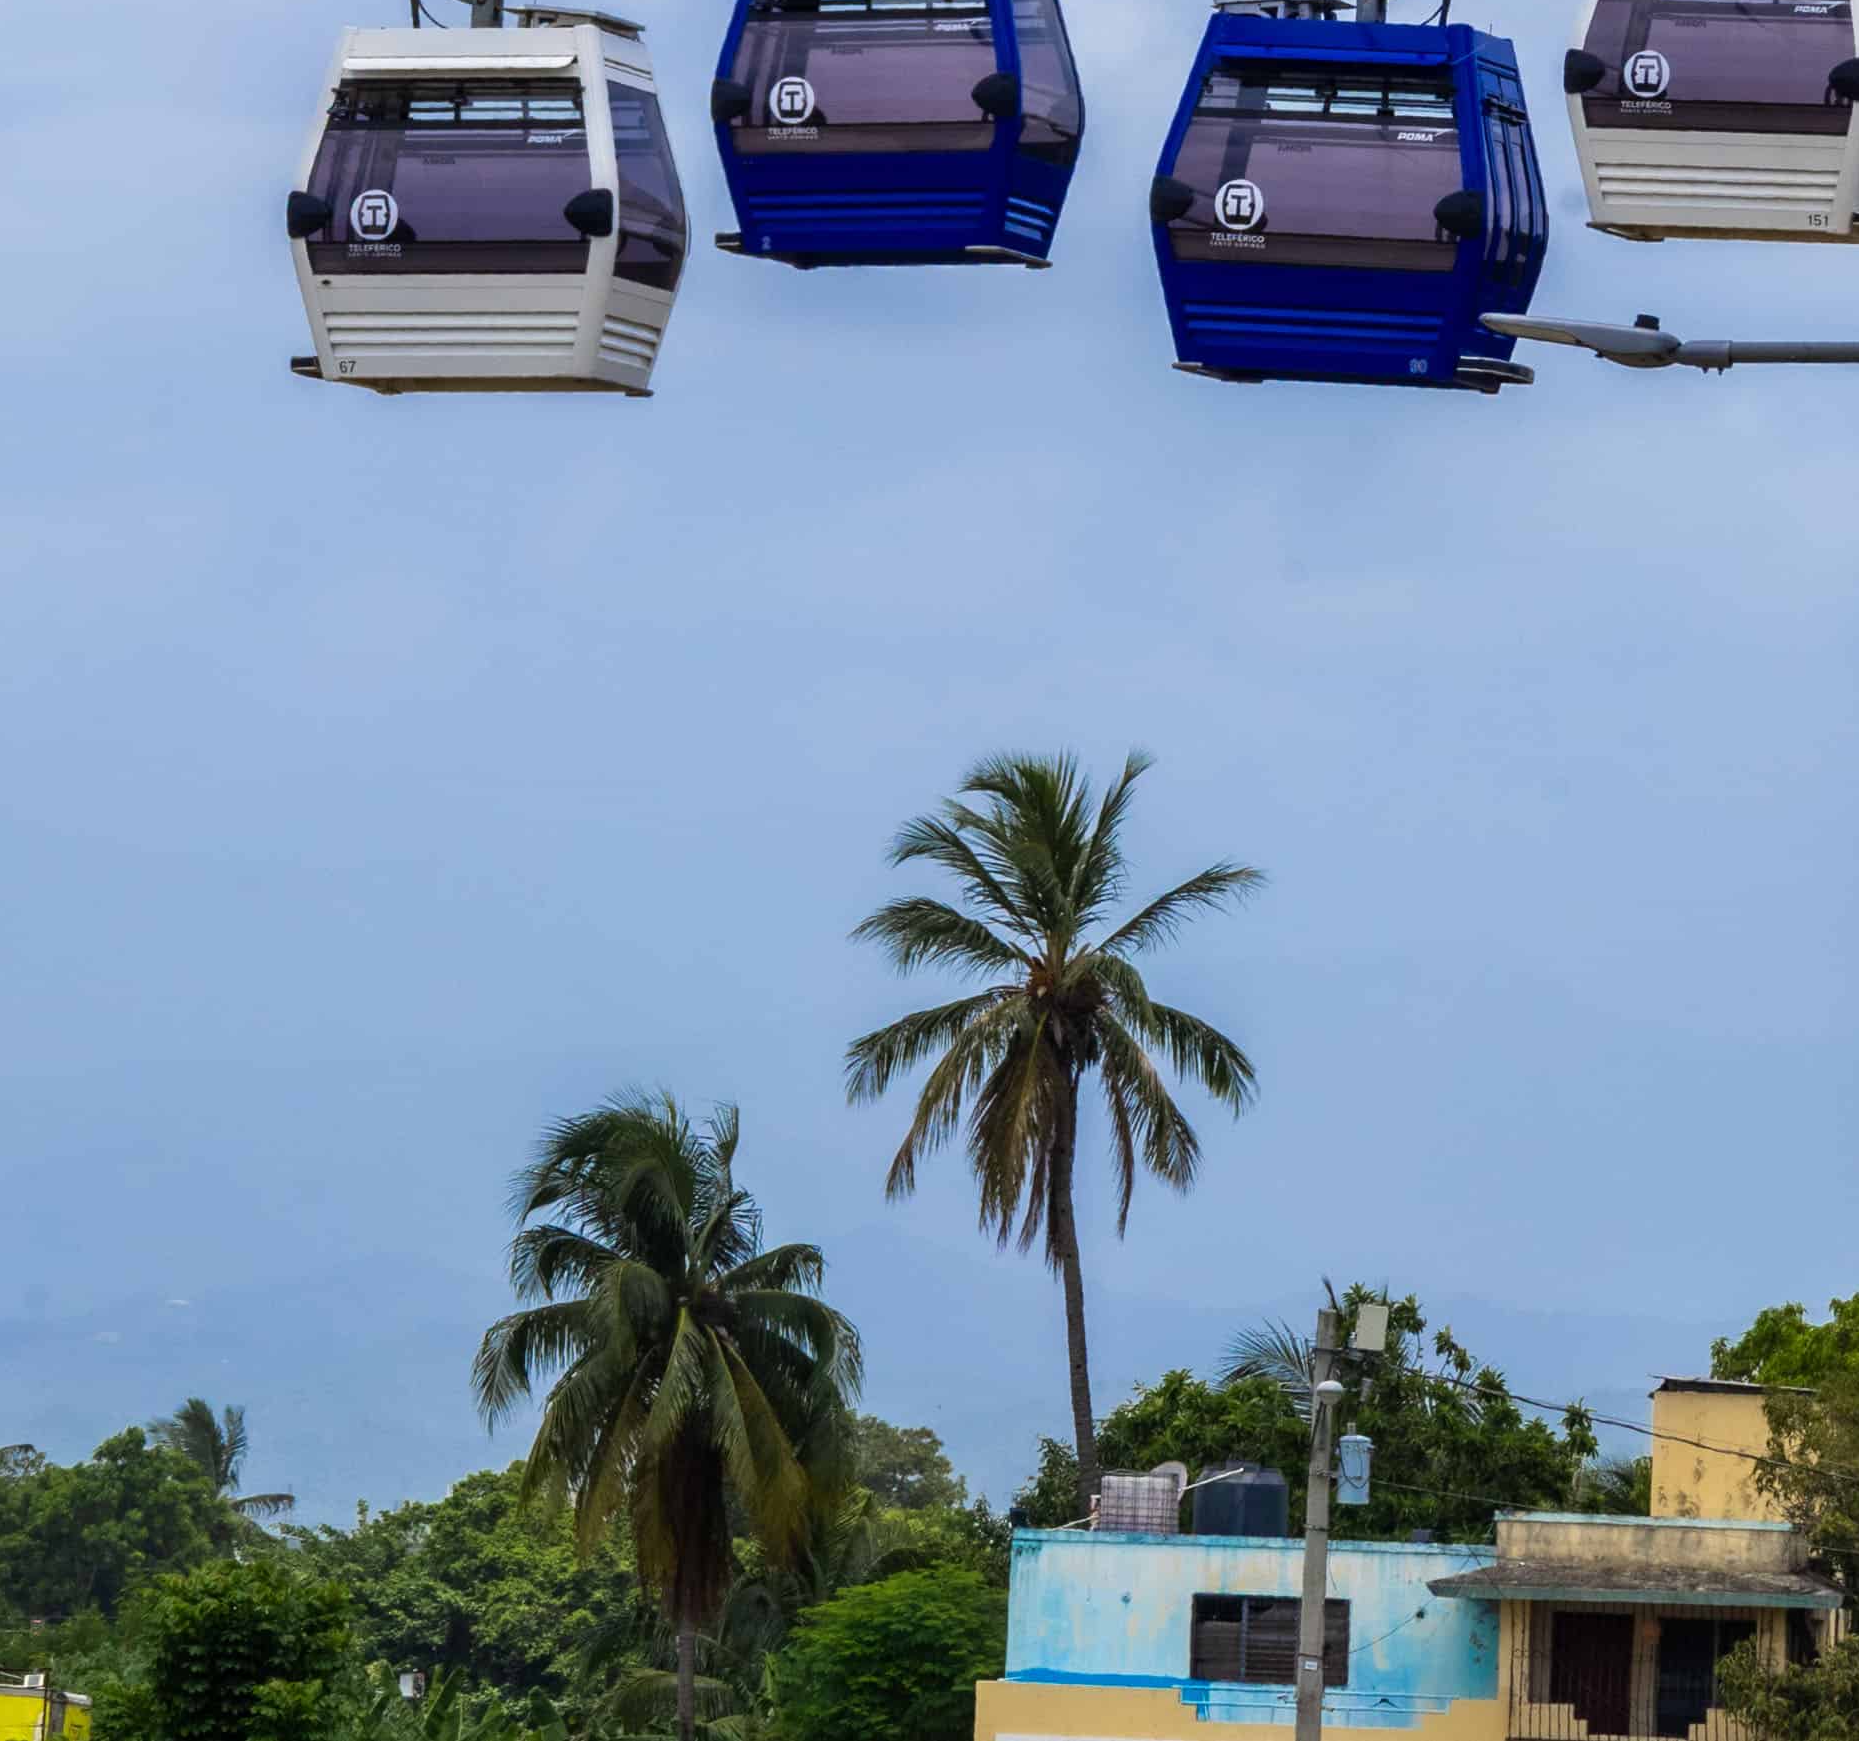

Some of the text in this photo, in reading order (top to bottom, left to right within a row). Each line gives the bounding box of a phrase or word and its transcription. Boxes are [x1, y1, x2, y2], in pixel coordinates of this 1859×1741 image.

[1397, 131, 1435, 142] POMA
[1809, 214, 1829, 227] 151
[1210, 231, 1266, 244] TELEFÉRICO
[339, 360, 357, 373] 67
